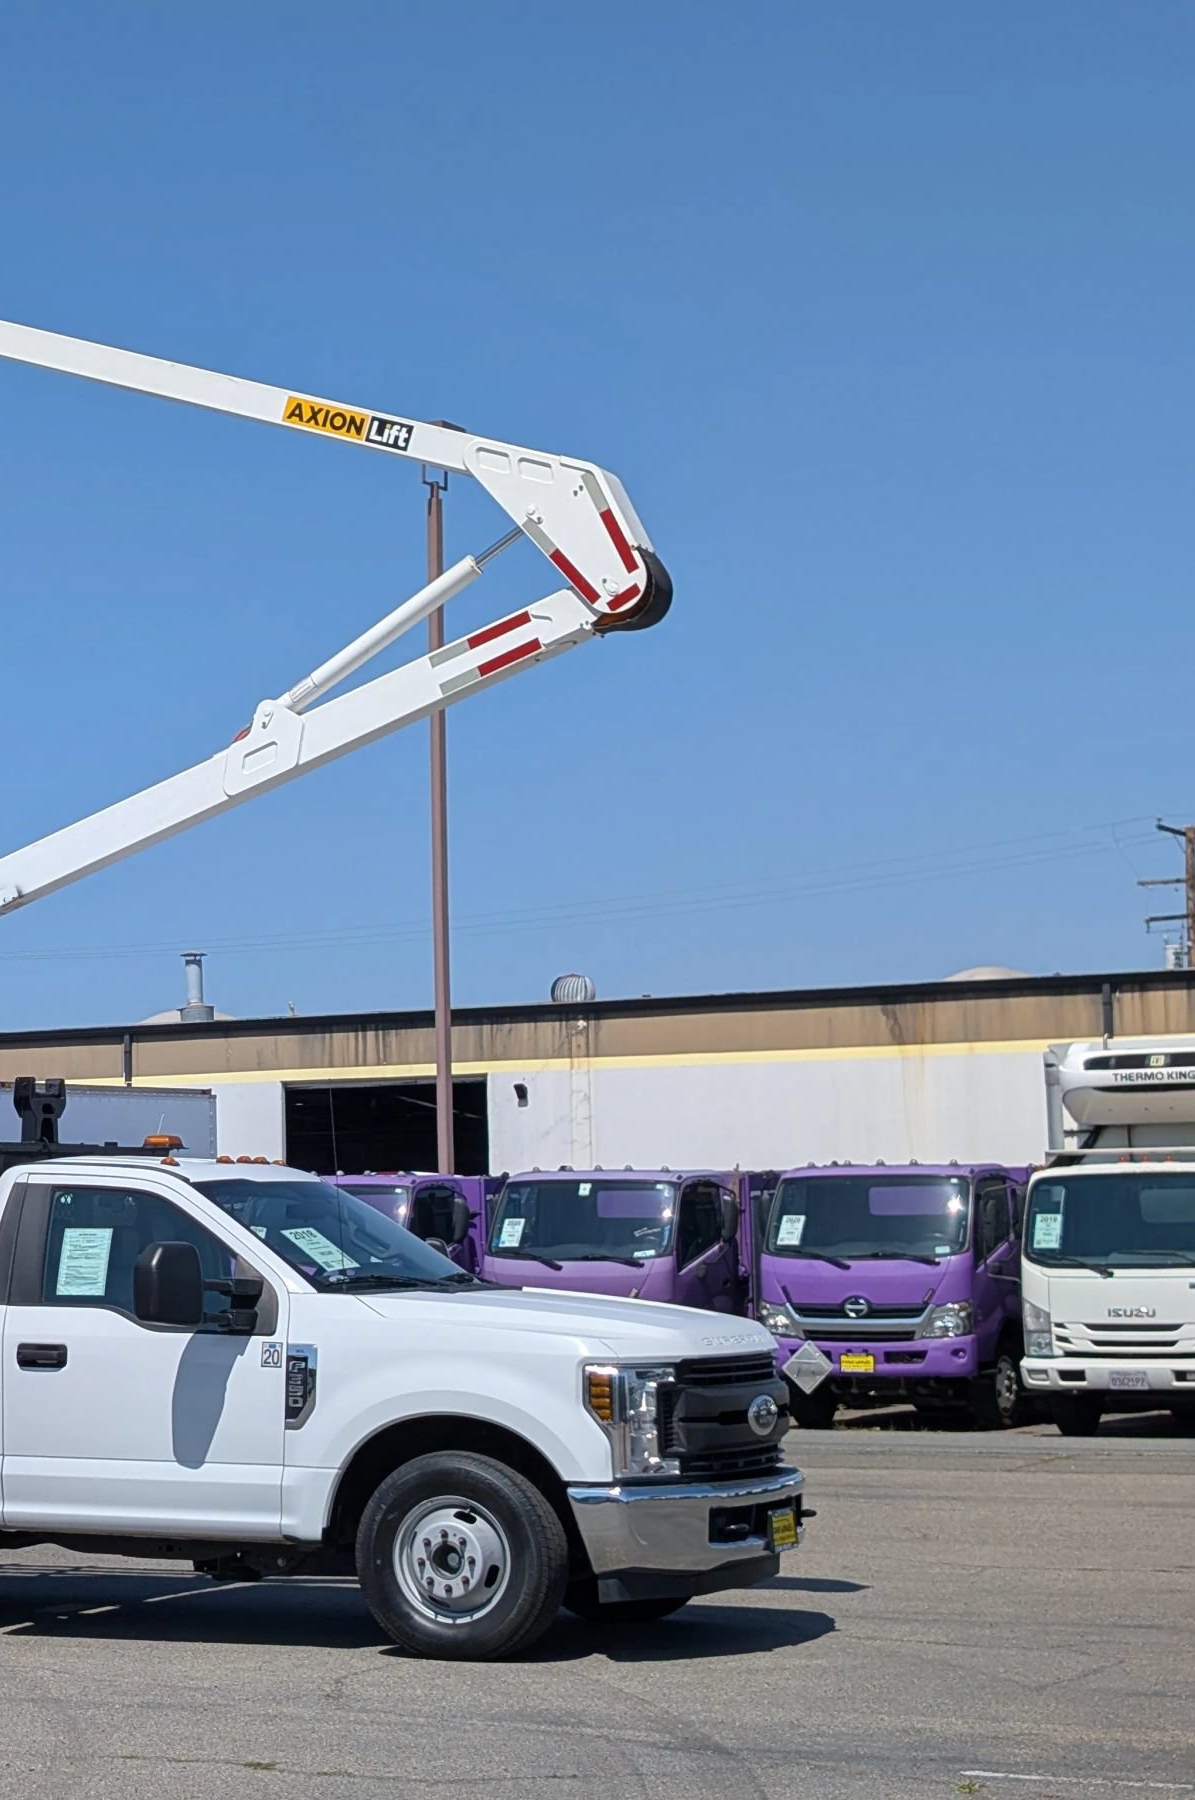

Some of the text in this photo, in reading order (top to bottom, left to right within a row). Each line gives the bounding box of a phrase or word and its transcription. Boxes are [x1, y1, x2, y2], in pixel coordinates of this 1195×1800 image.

[286, 402, 409, 447] AXION Lift
[1112, 1070, 1195, 1082] THERMO KING
[290, 1230, 317, 1240] 2018
[1107, 1308, 1156, 1318] ISUZU
[263, 1349, 280, 1365] 20
